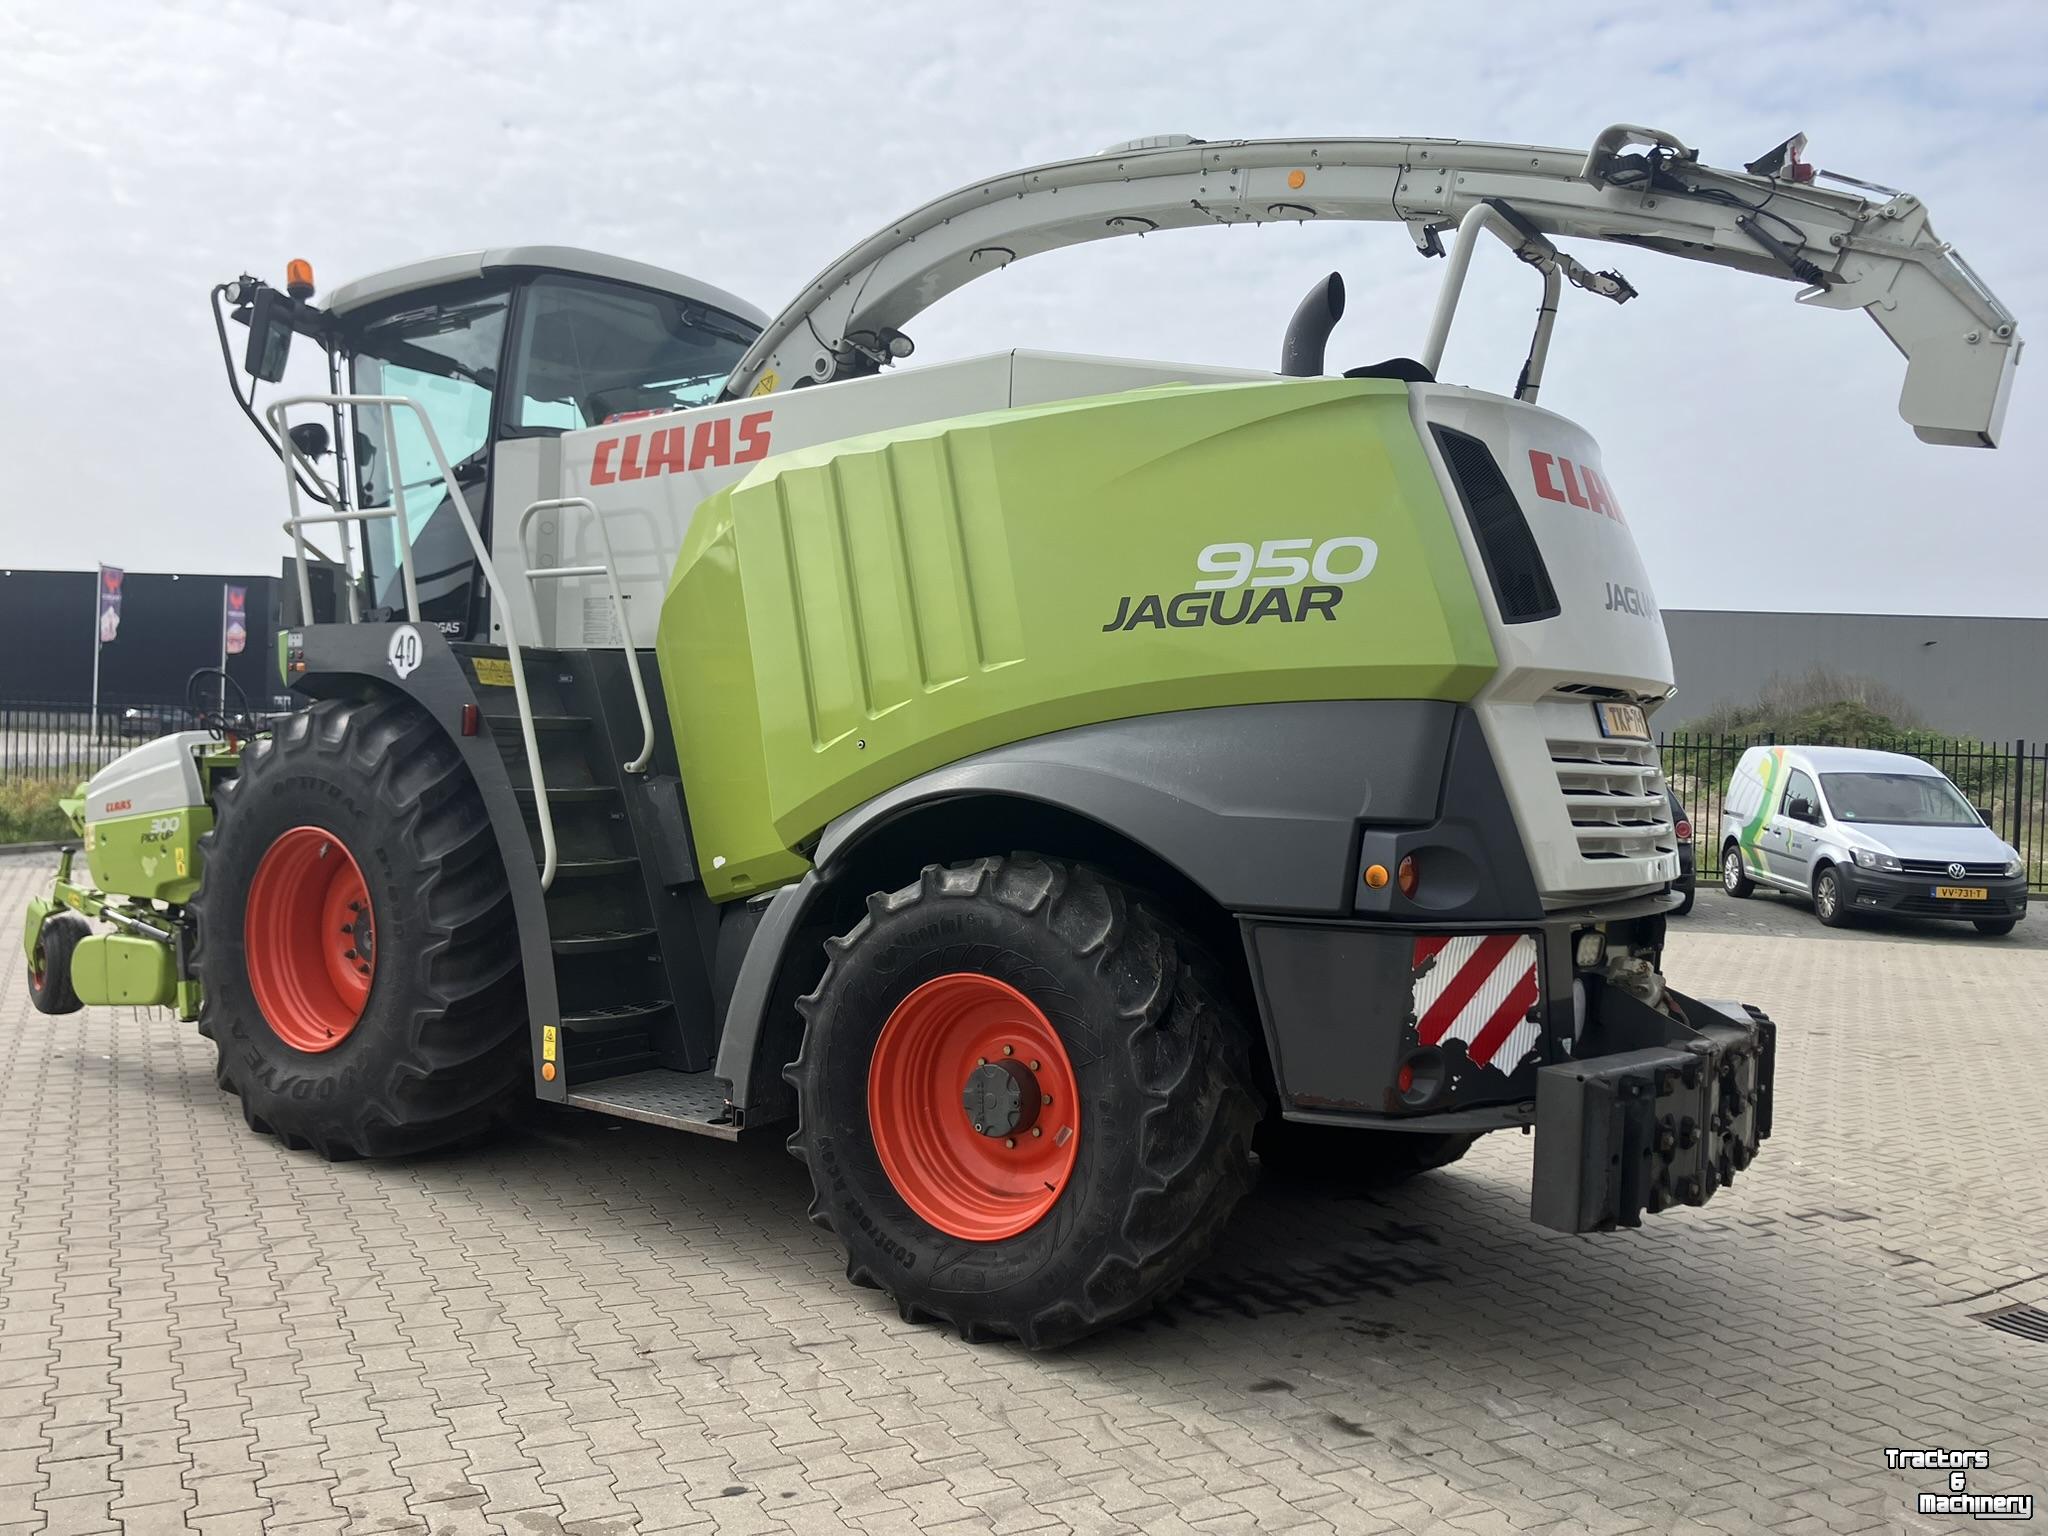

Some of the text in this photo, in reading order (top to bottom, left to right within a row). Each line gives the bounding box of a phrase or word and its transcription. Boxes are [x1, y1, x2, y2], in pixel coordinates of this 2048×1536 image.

[590, 410, 774, 486] CLAAS
[1195, 536, 1379, 591] 950
[1102, 585, 1344, 633] JAGUAR
[395, 635, 416, 667] 40
[106, 800, 132, 813] CLAAS
[151, 816, 180, 834] 300
